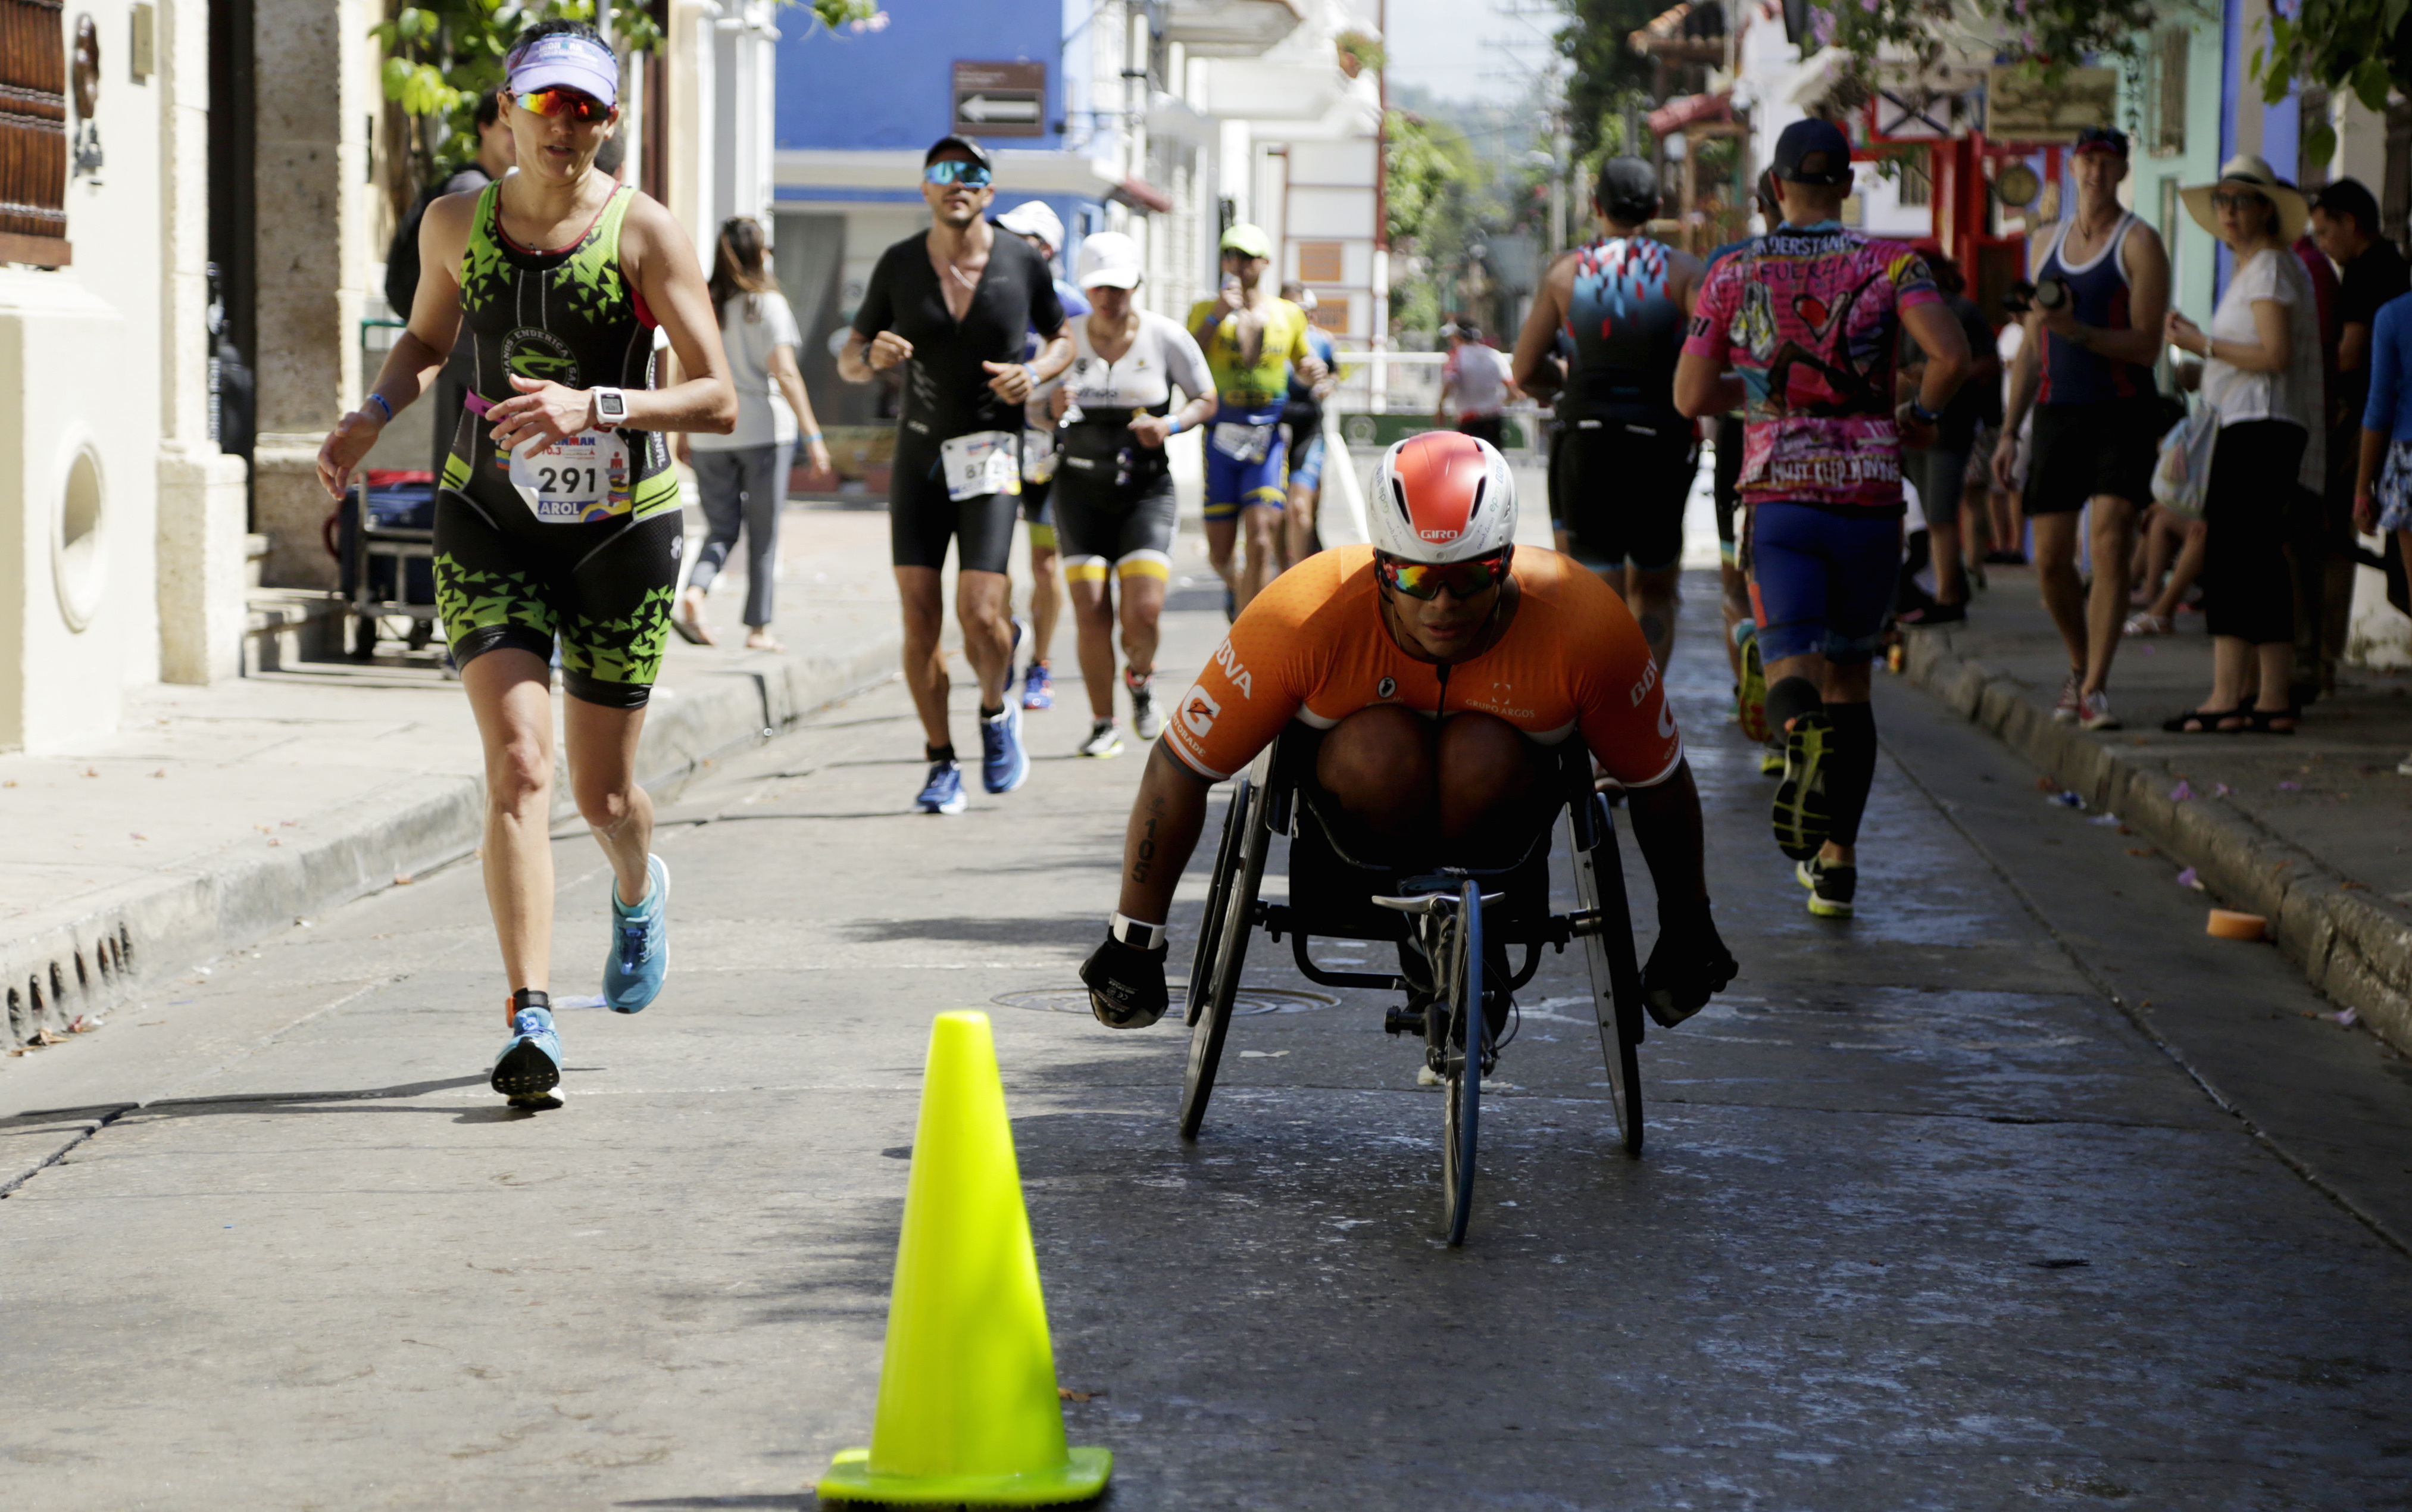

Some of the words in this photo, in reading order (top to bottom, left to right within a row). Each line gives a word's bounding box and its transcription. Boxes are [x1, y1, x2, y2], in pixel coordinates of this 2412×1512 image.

[514, 329, 568, 357] ENDERICA
[538, 467, 595, 493] 291
[540, 502, 580, 515] AROL
[1421, 530, 1458, 539] GIRO
[1216, 638, 1252, 700] BVA
[1466, 698, 1499, 713] GRUPO
[1501, 708, 1535, 718] ARGOS
